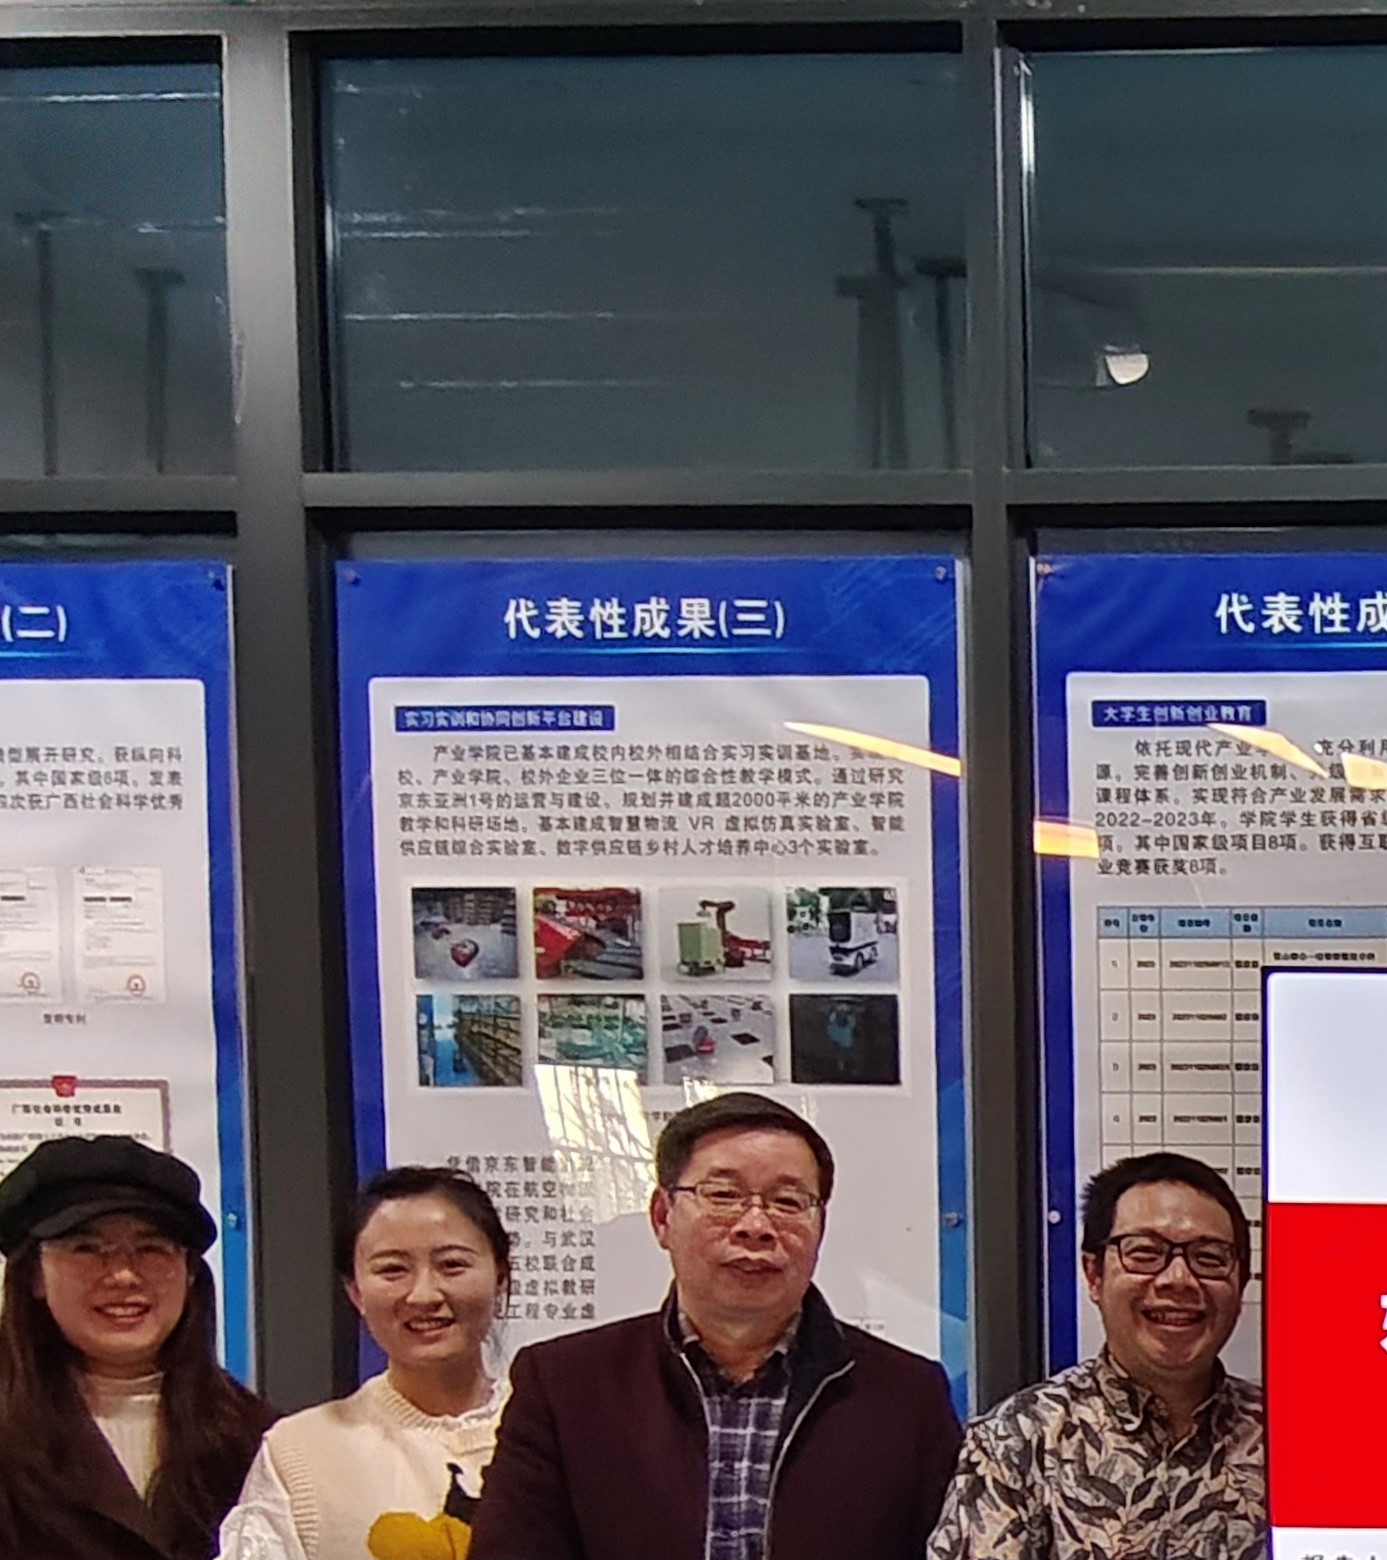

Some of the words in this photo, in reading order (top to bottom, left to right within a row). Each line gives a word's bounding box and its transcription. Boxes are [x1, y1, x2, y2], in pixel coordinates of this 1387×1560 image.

[504, 598, 786, 640] 代表性成果(三)
[1104, 705, 1252, 723] 大学生创新创业教育
[688, 816, 714, 832] VR
